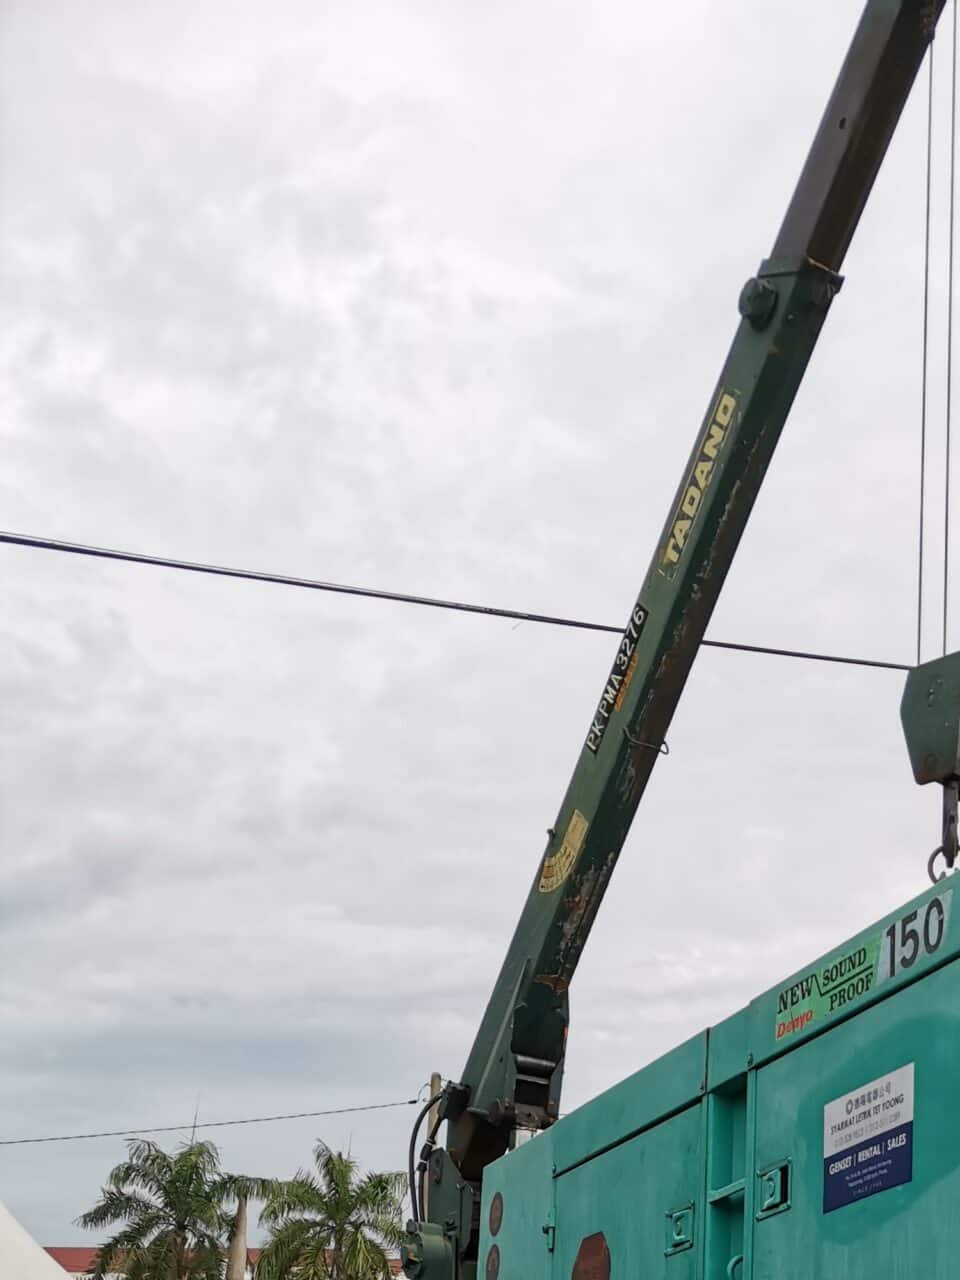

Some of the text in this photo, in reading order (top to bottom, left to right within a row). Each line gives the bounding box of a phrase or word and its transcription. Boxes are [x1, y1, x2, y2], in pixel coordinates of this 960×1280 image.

[663, 393, 736, 563] TADANO
[599, 673, 623, 718] PMA
[616, 606, 645, 671] 3276
[886, 897, 944, 978] 150
[777, 947, 867, 1015] NEW SOUND
[828, 972, 874, 1012] PROOF
[828, 1156, 853, 1176] GENSET
[857, 1143, 881, 1163] RENTAL
[887, 1133, 907, 1151] SALES
